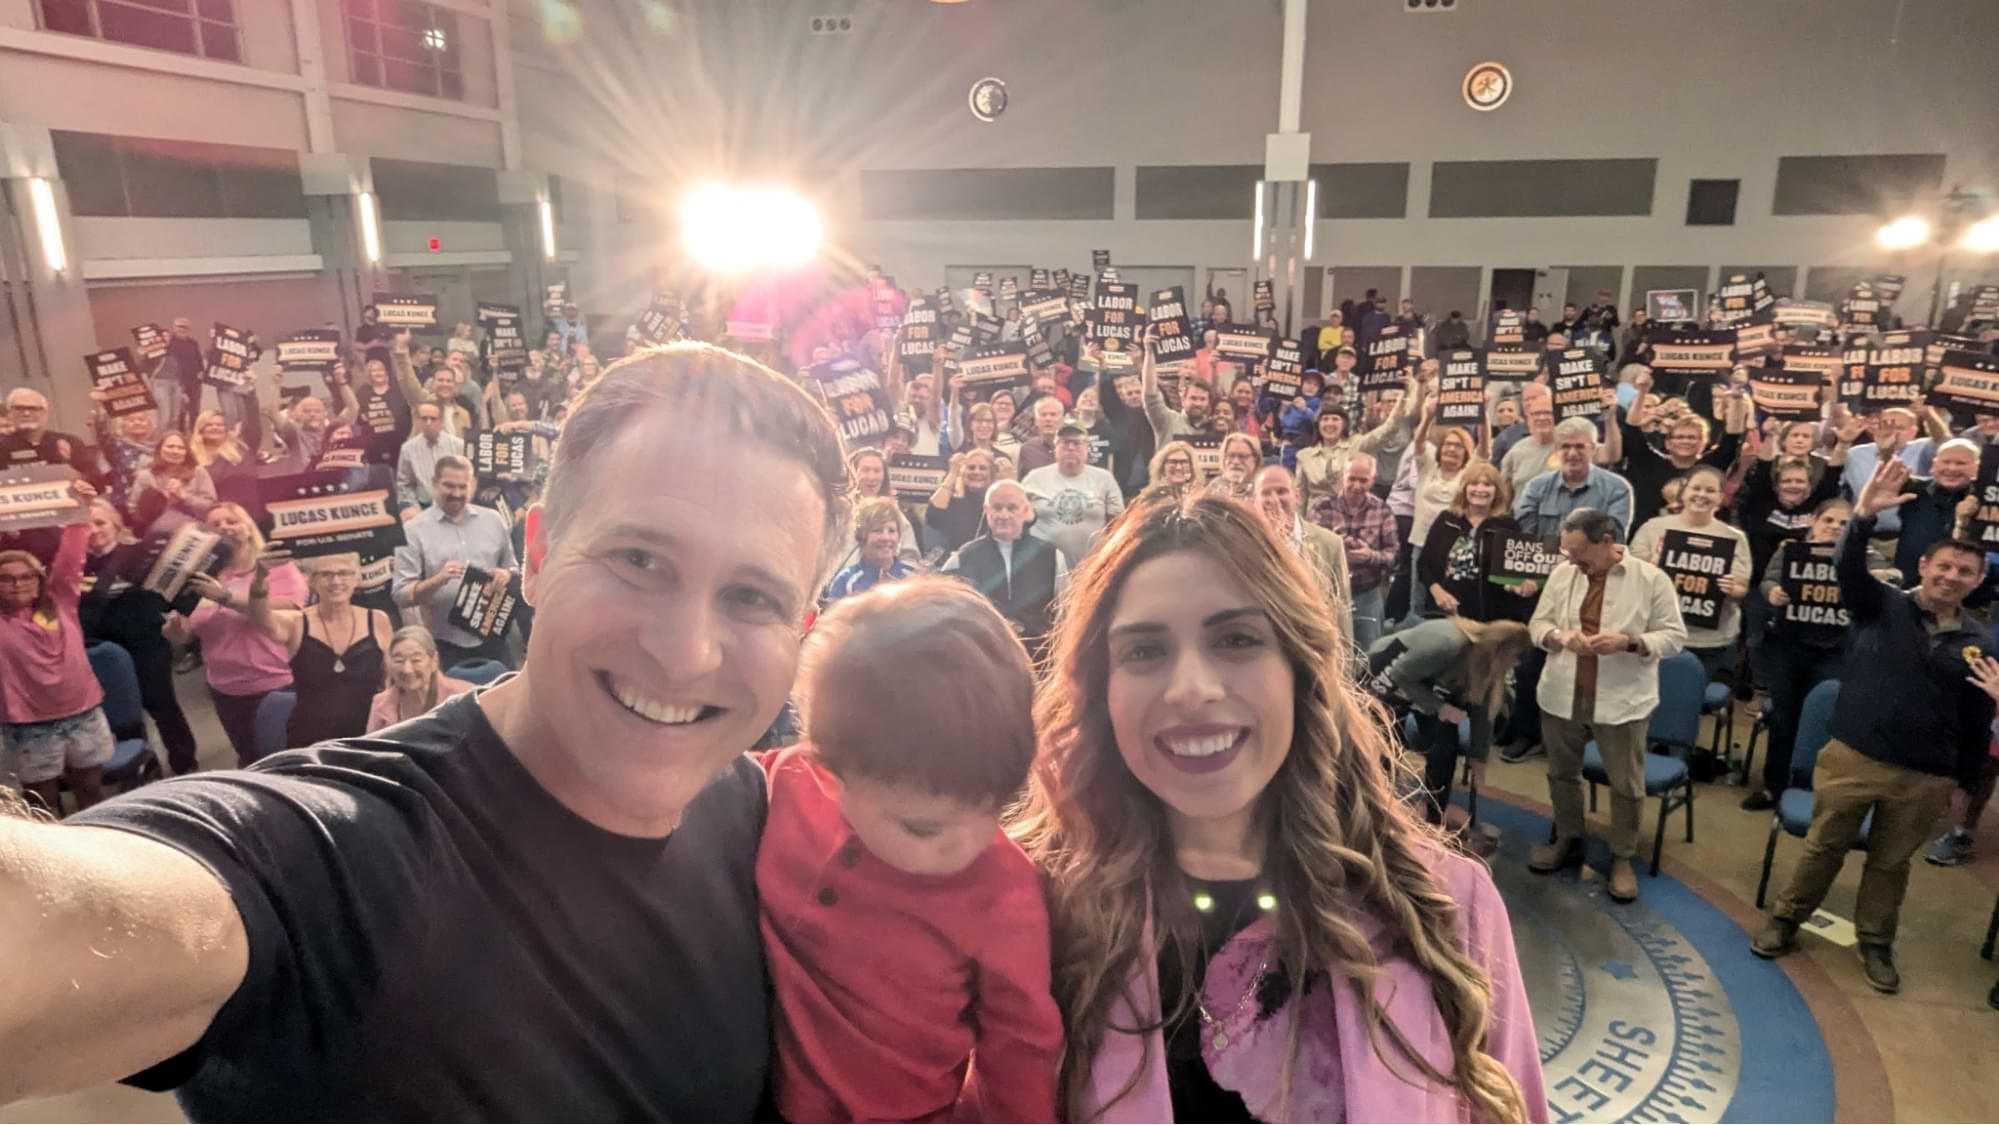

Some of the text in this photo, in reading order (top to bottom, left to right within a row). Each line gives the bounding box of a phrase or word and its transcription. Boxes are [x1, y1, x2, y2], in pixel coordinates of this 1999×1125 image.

[1098, 296, 1133, 310] LABOR
[1104, 310, 1124, 323] FOR
[1150, 302, 1183, 321] LABOR
[908, 326, 928, 338] FOR
[1096, 325, 1130, 338] LUCAS
[1158, 320, 1180, 336] FOR
[902, 341, 935, 355] LUCAS
[1156, 336, 1191, 354] LUCAS
[1368, 336, 1407, 356] LABOR
[1276, 348, 1301, 362] MAKE
[1375, 354, 1398, 370] FOR
[1660, 352, 1722, 360] LUCAS KUNCE
[1869, 348, 1923, 365] LABOR
[208, 365, 246, 386] LUCAS
[966, 364, 992, 376] LUCAS
[1446, 362, 1478, 376] MAKE
[1558, 360, 1594, 376] MAKE
[1878, 367, 1912, 383] FOR
[1866, 384, 1920, 400] LUCAS
[1443, 404, 1480, 418] AGAIN!
[478, 434, 493, 472] LABOR
[496, 443, 509, 464] FOR
[511, 436, 524, 474] LUCAS
[12, 490, 61, 503] KUNCE
[280, 502, 378, 526] LUCAS KUNCE
[1506, 538, 1544, 553] BANS
[1504, 549, 1532, 562] OFF
[1665, 550, 1726, 575] LABOR
[1674, 573, 1708, 594] FOR
[1801, 584, 1840, 604] FOR
[1680, 596, 1716, 617] CAS
[1786, 604, 1851, 626] LUCAS
